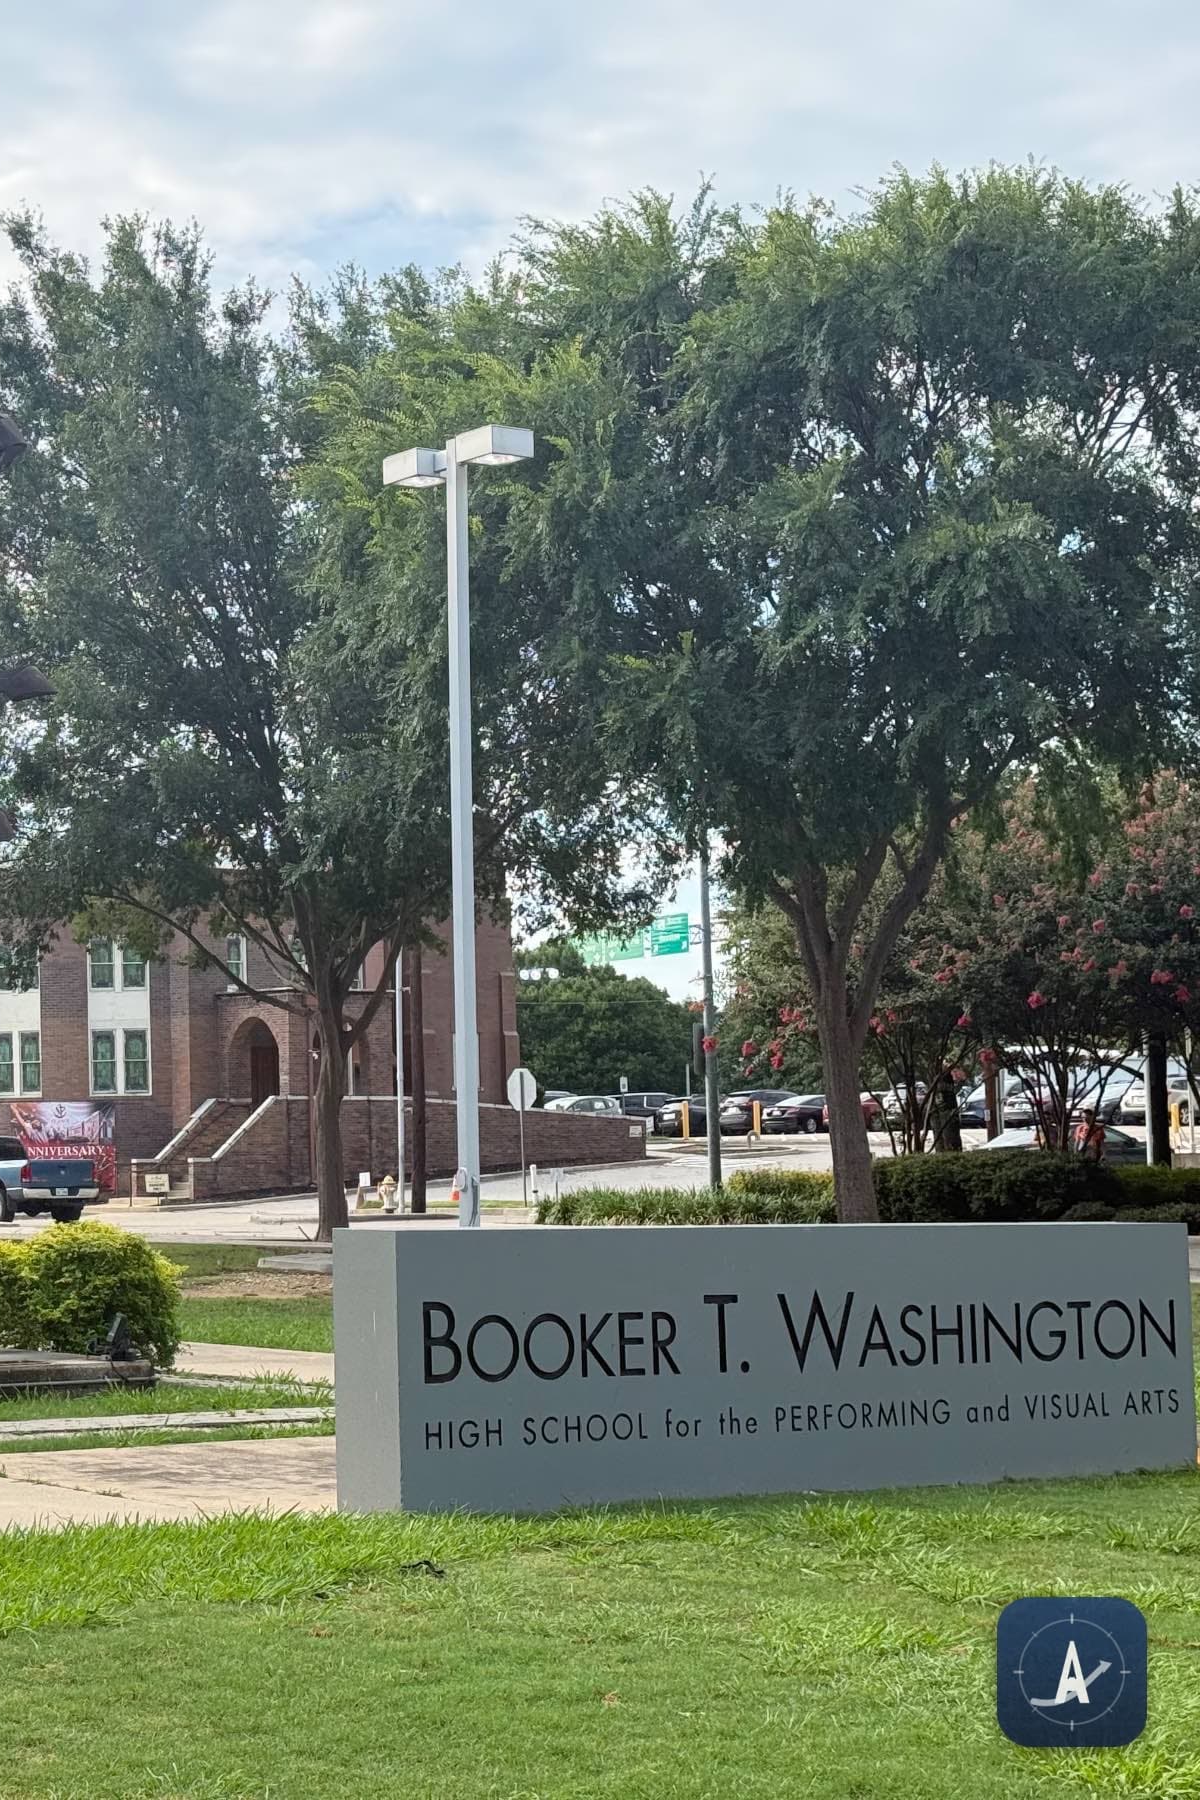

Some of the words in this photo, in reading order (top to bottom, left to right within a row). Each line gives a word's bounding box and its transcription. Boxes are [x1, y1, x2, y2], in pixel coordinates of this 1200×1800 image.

[28, 1145, 105, 1157] NNIVERSARY
[703, 1295, 750, 1374] T.
[425, 1419, 503, 1451] HIGH
[522, 1412, 649, 1446] SCHOOL
[665, 1408, 702, 1438] for
[718, 1406, 758, 1436] the
[775, 1398, 951, 1433] PERFORMING
[966, 1394, 1010, 1424] and
[1024, 1391, 1110, 1420] VISUAL
[1123, 1388, 1179, 1416] ARTS
